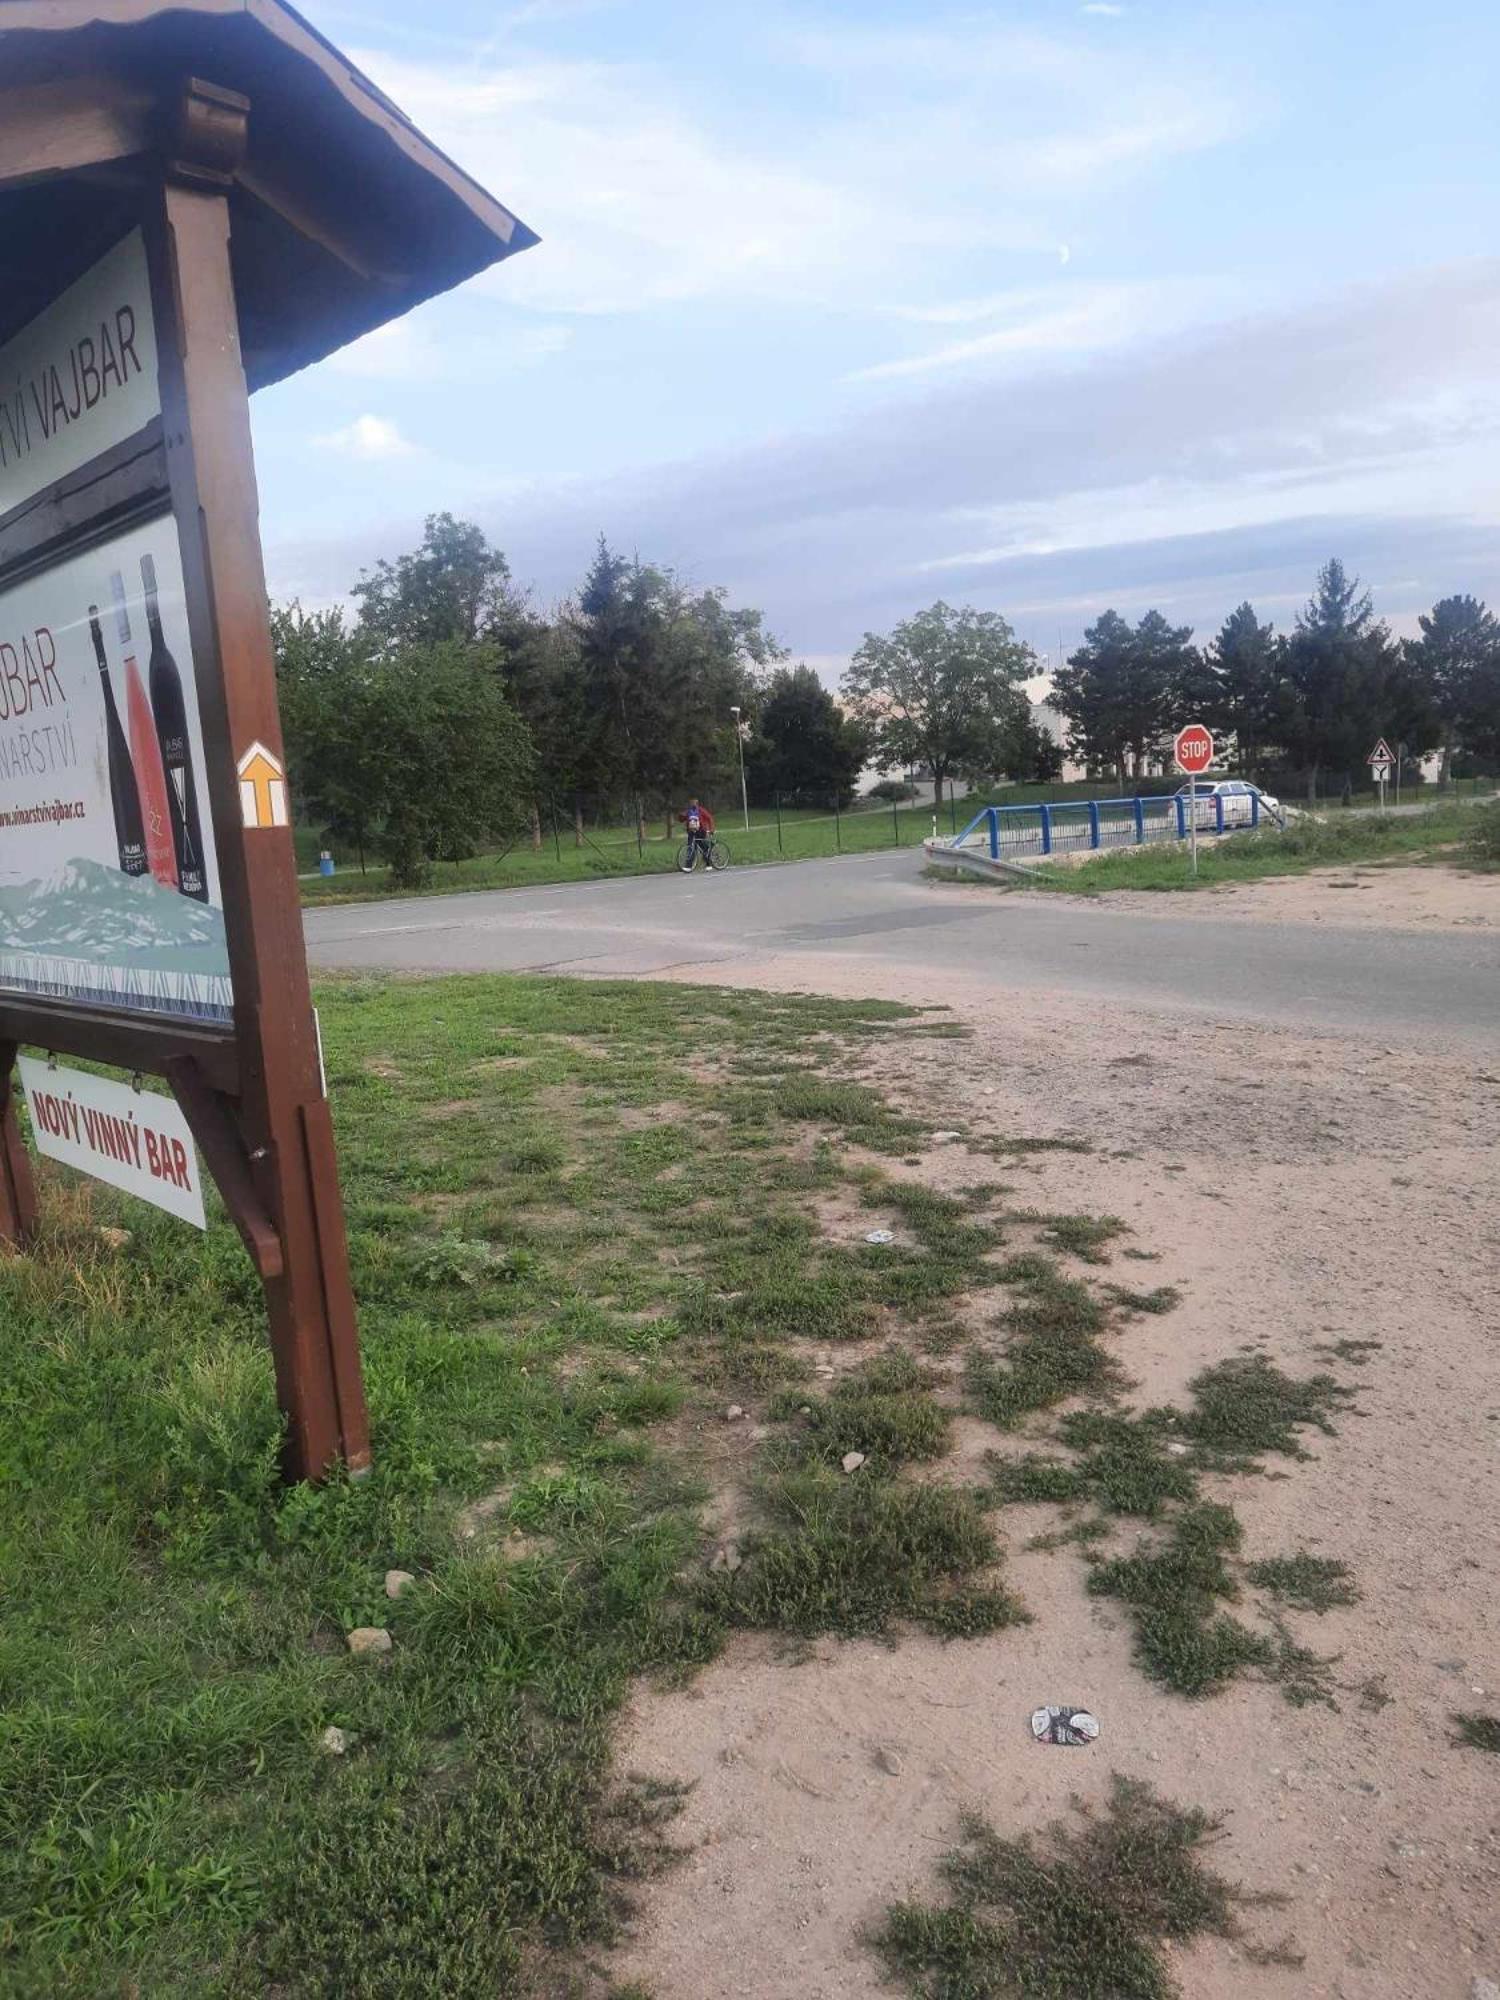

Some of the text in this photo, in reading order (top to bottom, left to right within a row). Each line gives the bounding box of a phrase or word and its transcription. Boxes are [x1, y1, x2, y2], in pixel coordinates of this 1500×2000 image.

[30, 304, 142, 439] VAJBAR
[1181, 740, 1208, 758] STOP
[32, 1090, 192, 1192] NOVÝ VINNÝ BAR
